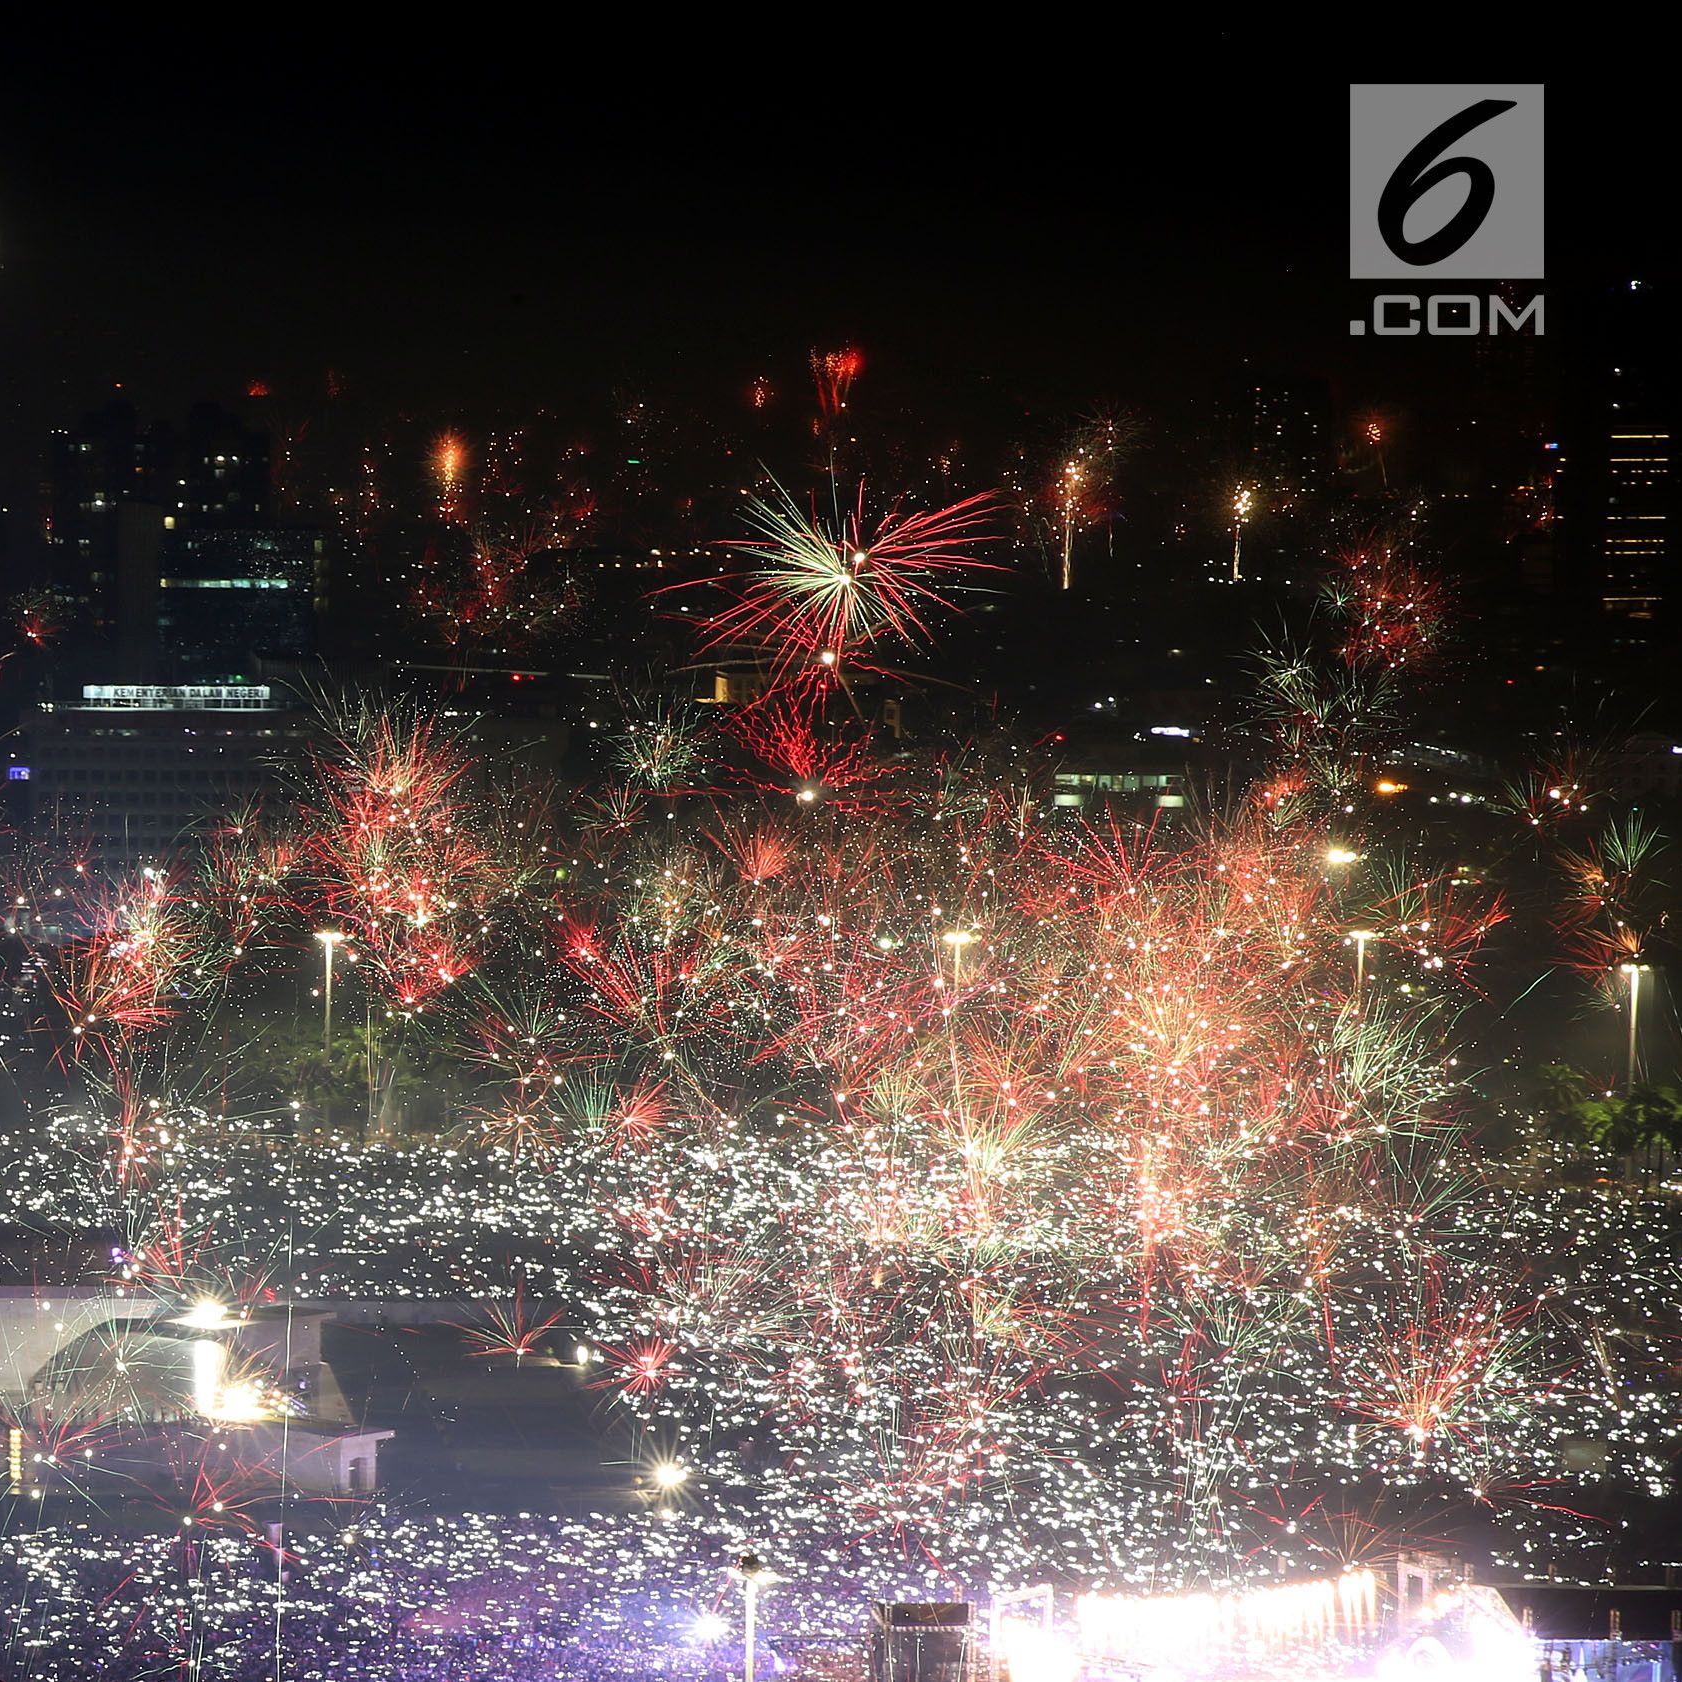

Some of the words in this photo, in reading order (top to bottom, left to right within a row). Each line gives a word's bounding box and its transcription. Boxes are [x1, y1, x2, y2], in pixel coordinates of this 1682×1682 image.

[113, 687, 186, 698] KEMENTERIAN
[189, 687, 223, 698] DALAM
[226, 687, 264, 698] NEGERI
